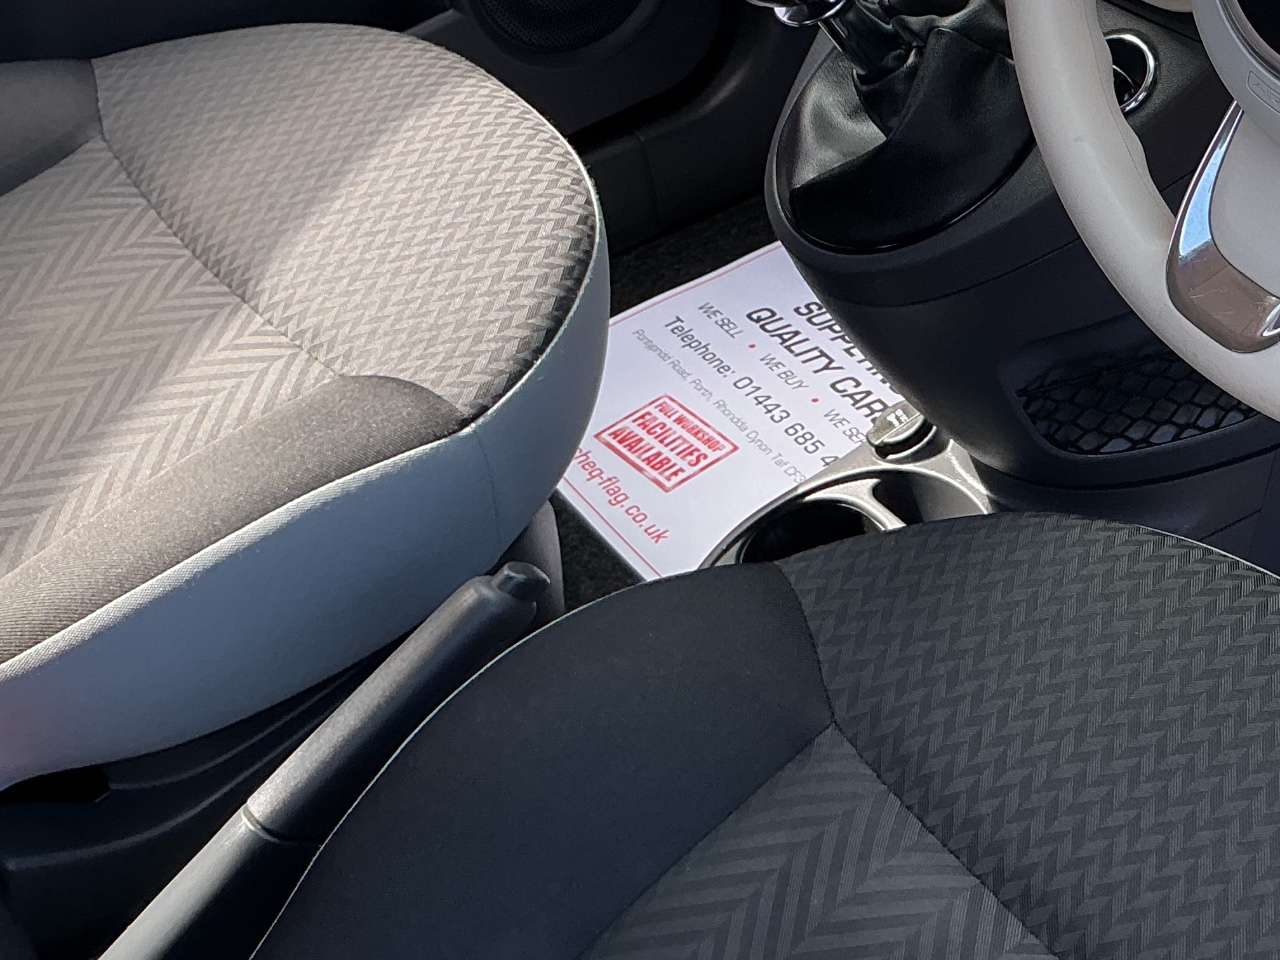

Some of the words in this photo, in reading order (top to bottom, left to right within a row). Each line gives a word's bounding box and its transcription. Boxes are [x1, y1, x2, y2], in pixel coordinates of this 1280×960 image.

[664, 315, 737, 378] Telephone:
[732, 376, 791, 424] 01443
[784, 422, 825, 454] 685
[698, 302, 723, 320] WE
[714, 316, 744, 340] SELL
[759, 352, 786, 372] WE
[777, 367, 808, 390] BUY
[823, 408, 850, 429] WE
[746, 307, 845, 374] QUALITY
[829, 376, 890, 424] CAR
[607, 425, 687, 482] AVAILABLE
[632, 411, 709, 468] FACILITIES
[654, 400, 680, 420] FULL
[672, 413, 726, 452] WORKSHOP
[712, 398, 748, 433] Rhondda
[745, 430, 773, 456] Cynon
[770, 452, 790, 468] Taf
